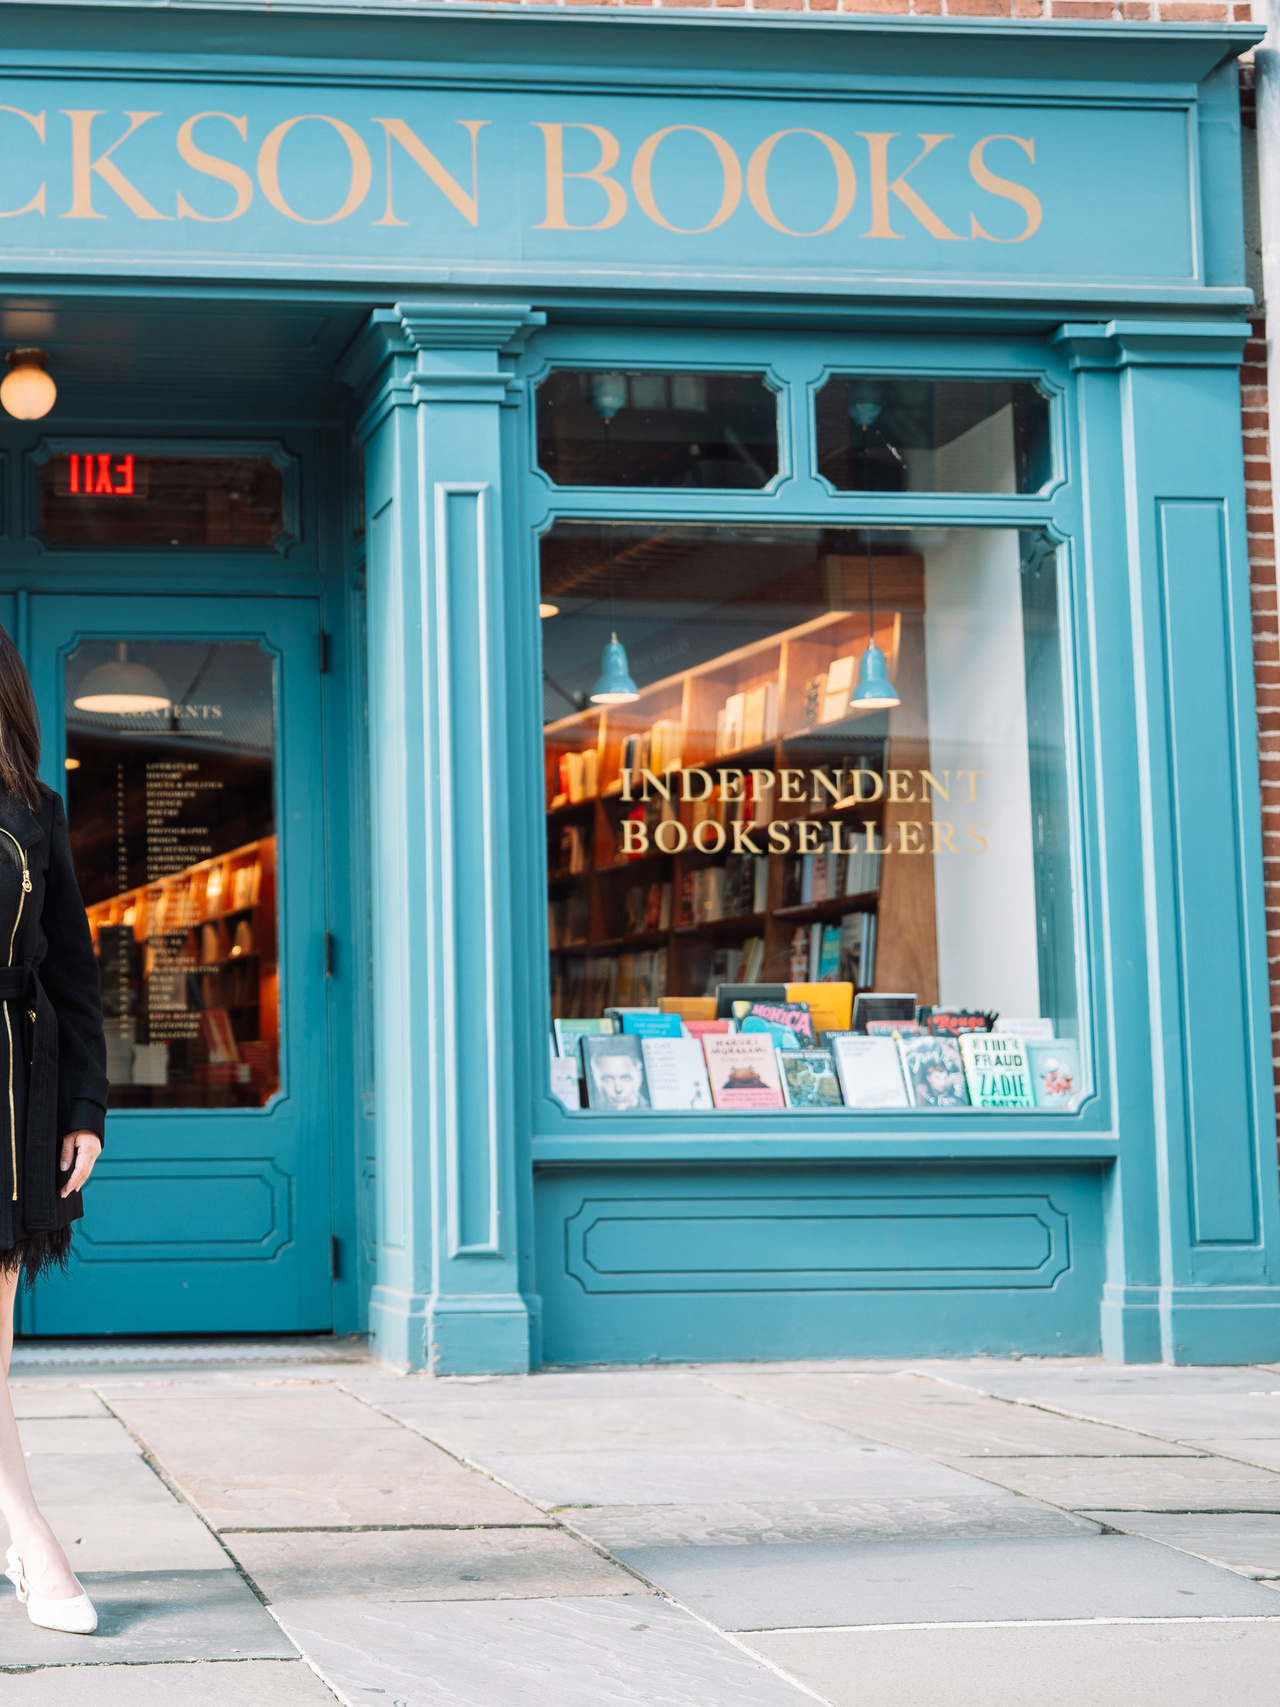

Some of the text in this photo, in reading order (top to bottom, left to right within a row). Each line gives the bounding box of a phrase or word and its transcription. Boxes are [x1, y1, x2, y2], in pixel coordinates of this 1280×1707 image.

[531, 121, 1043, 244] BOOKS
[619, 768, 989, 803] INDEPENDENT
[620, 819, 990, 855] BOOKSELLERS
[751, 1003, 812, 1037] MONICA
[932, 1014, 985, 1036] Rouge
[711, 1048, 767, 1056] MURAKAMI
[974, 1054, 1023, 1067] FRAUD
[981, 1073, 1025, 1097] ZADIE
